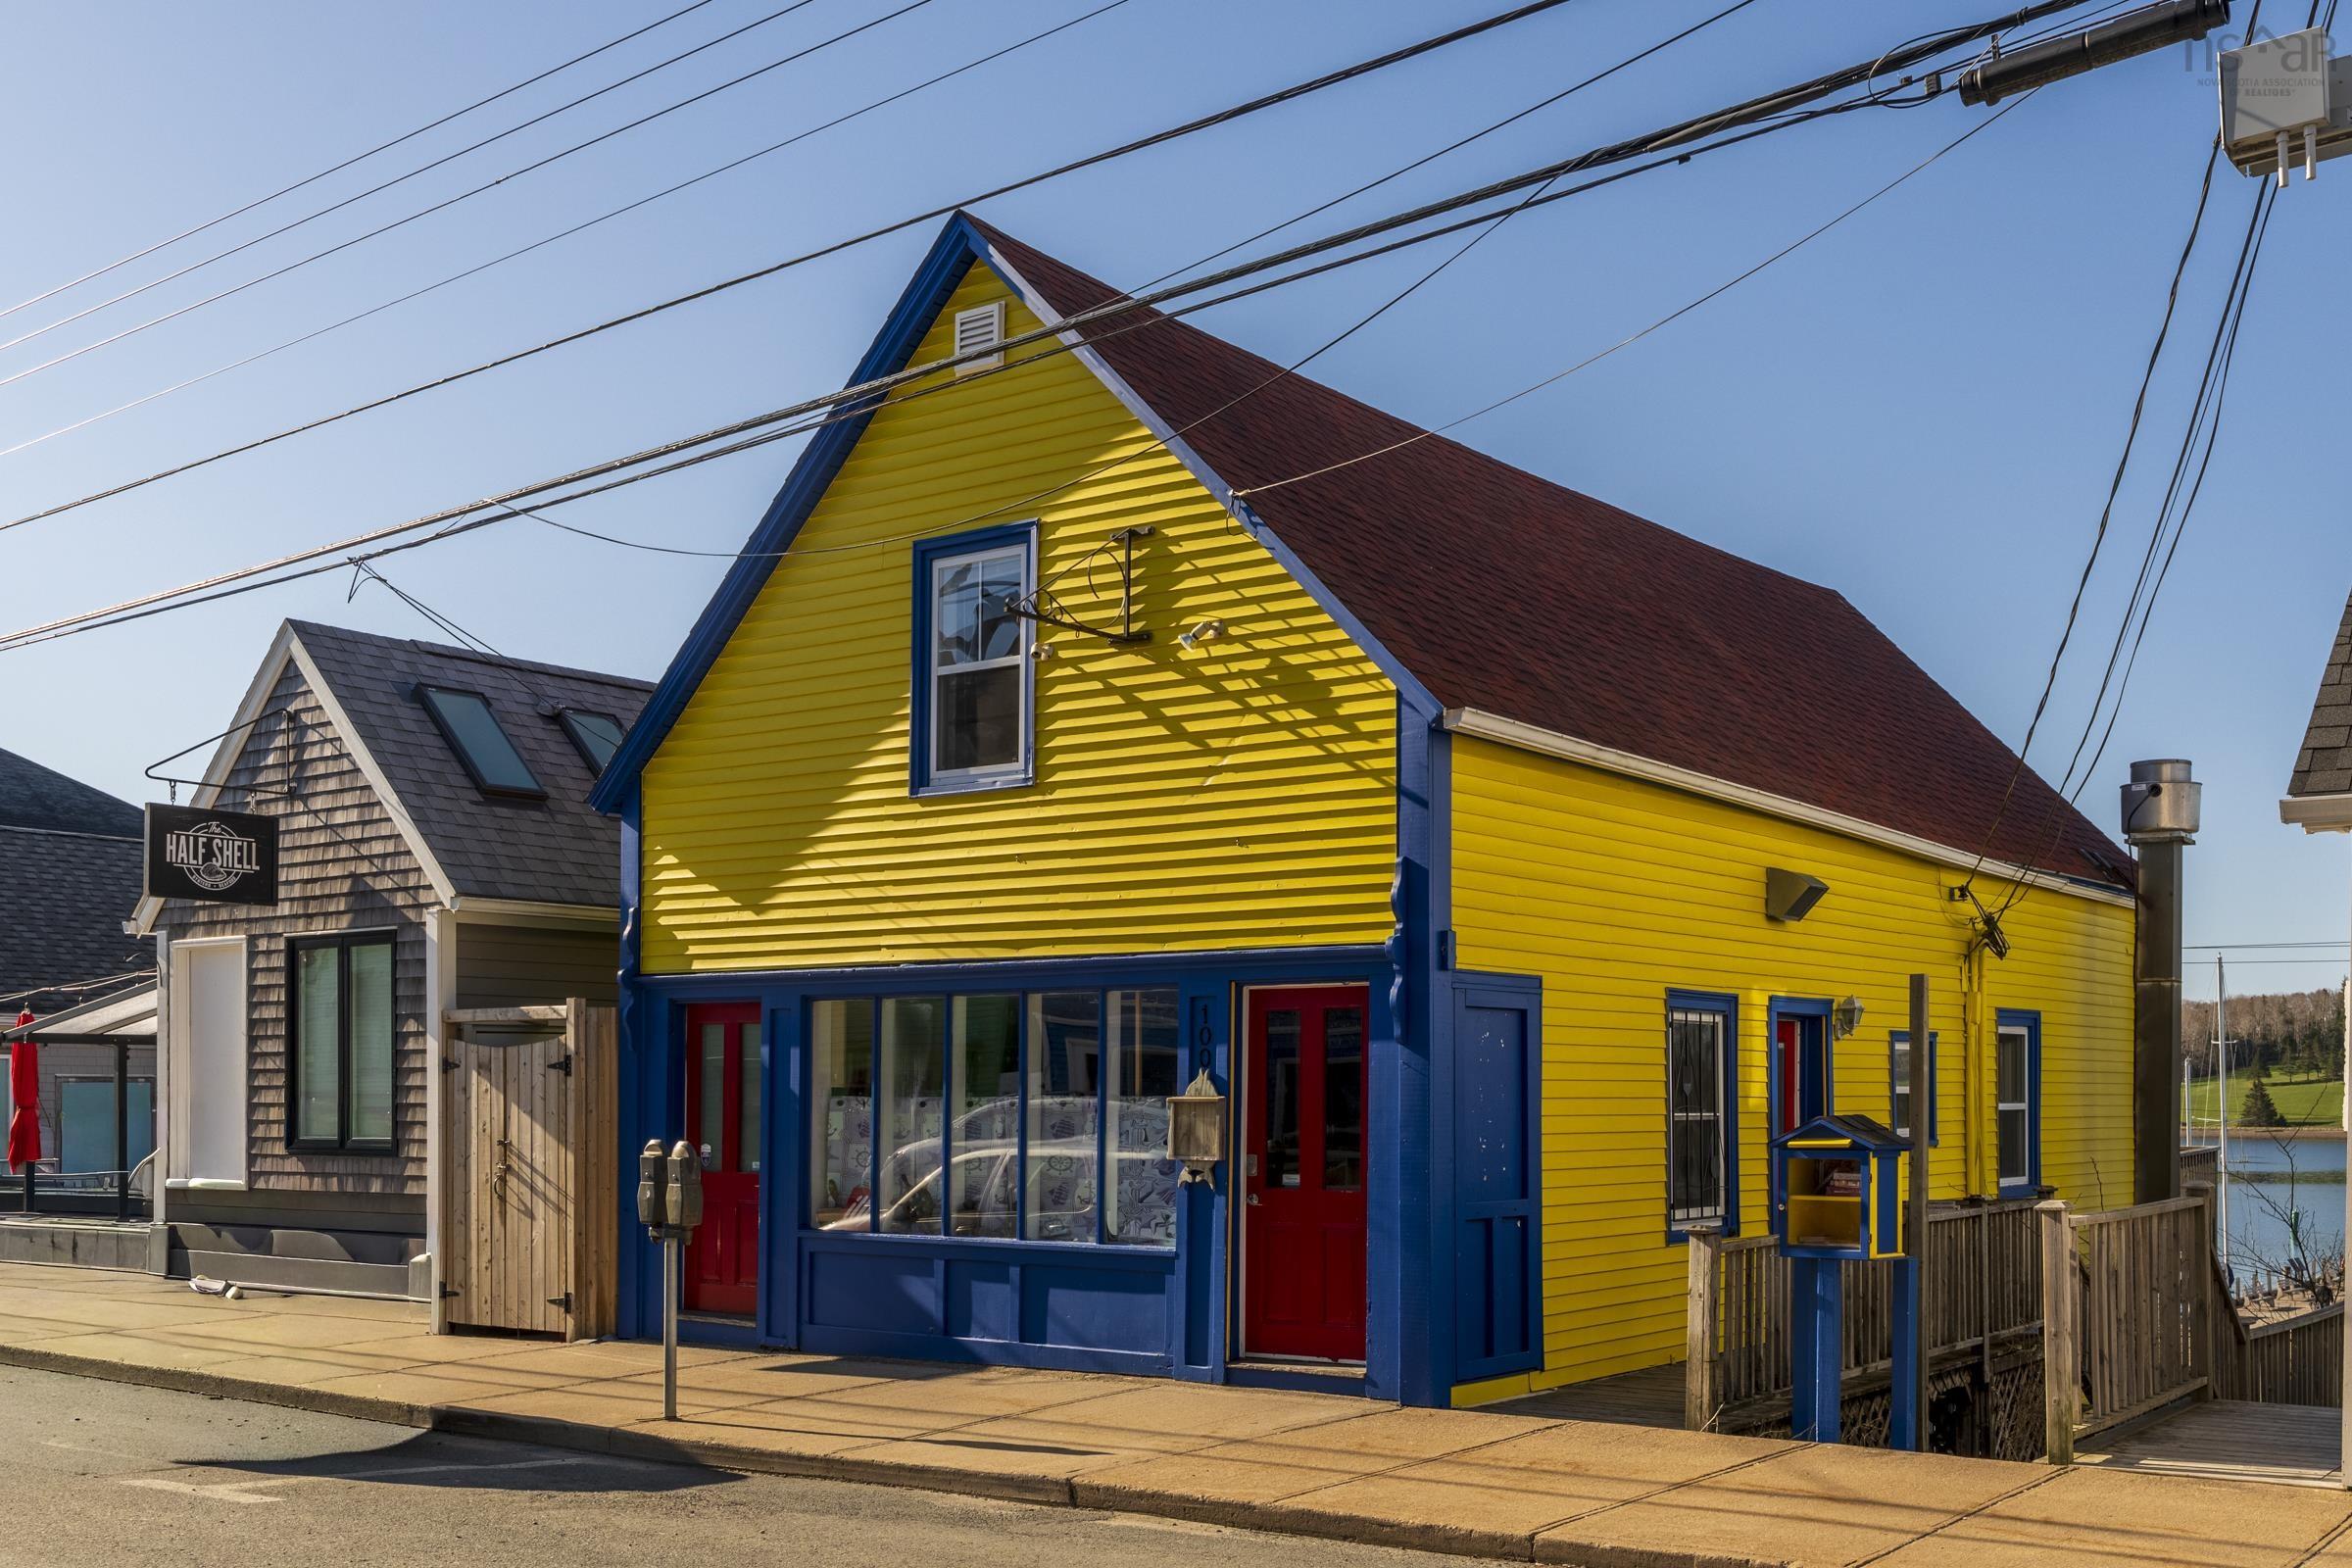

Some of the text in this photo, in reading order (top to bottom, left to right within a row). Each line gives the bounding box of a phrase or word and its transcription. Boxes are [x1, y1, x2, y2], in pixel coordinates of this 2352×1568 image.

[208, 821, 221, 833] The
[166, 833, 260, 870] HALF SHELL
[1200, 1004, 1211, 1067] 100
